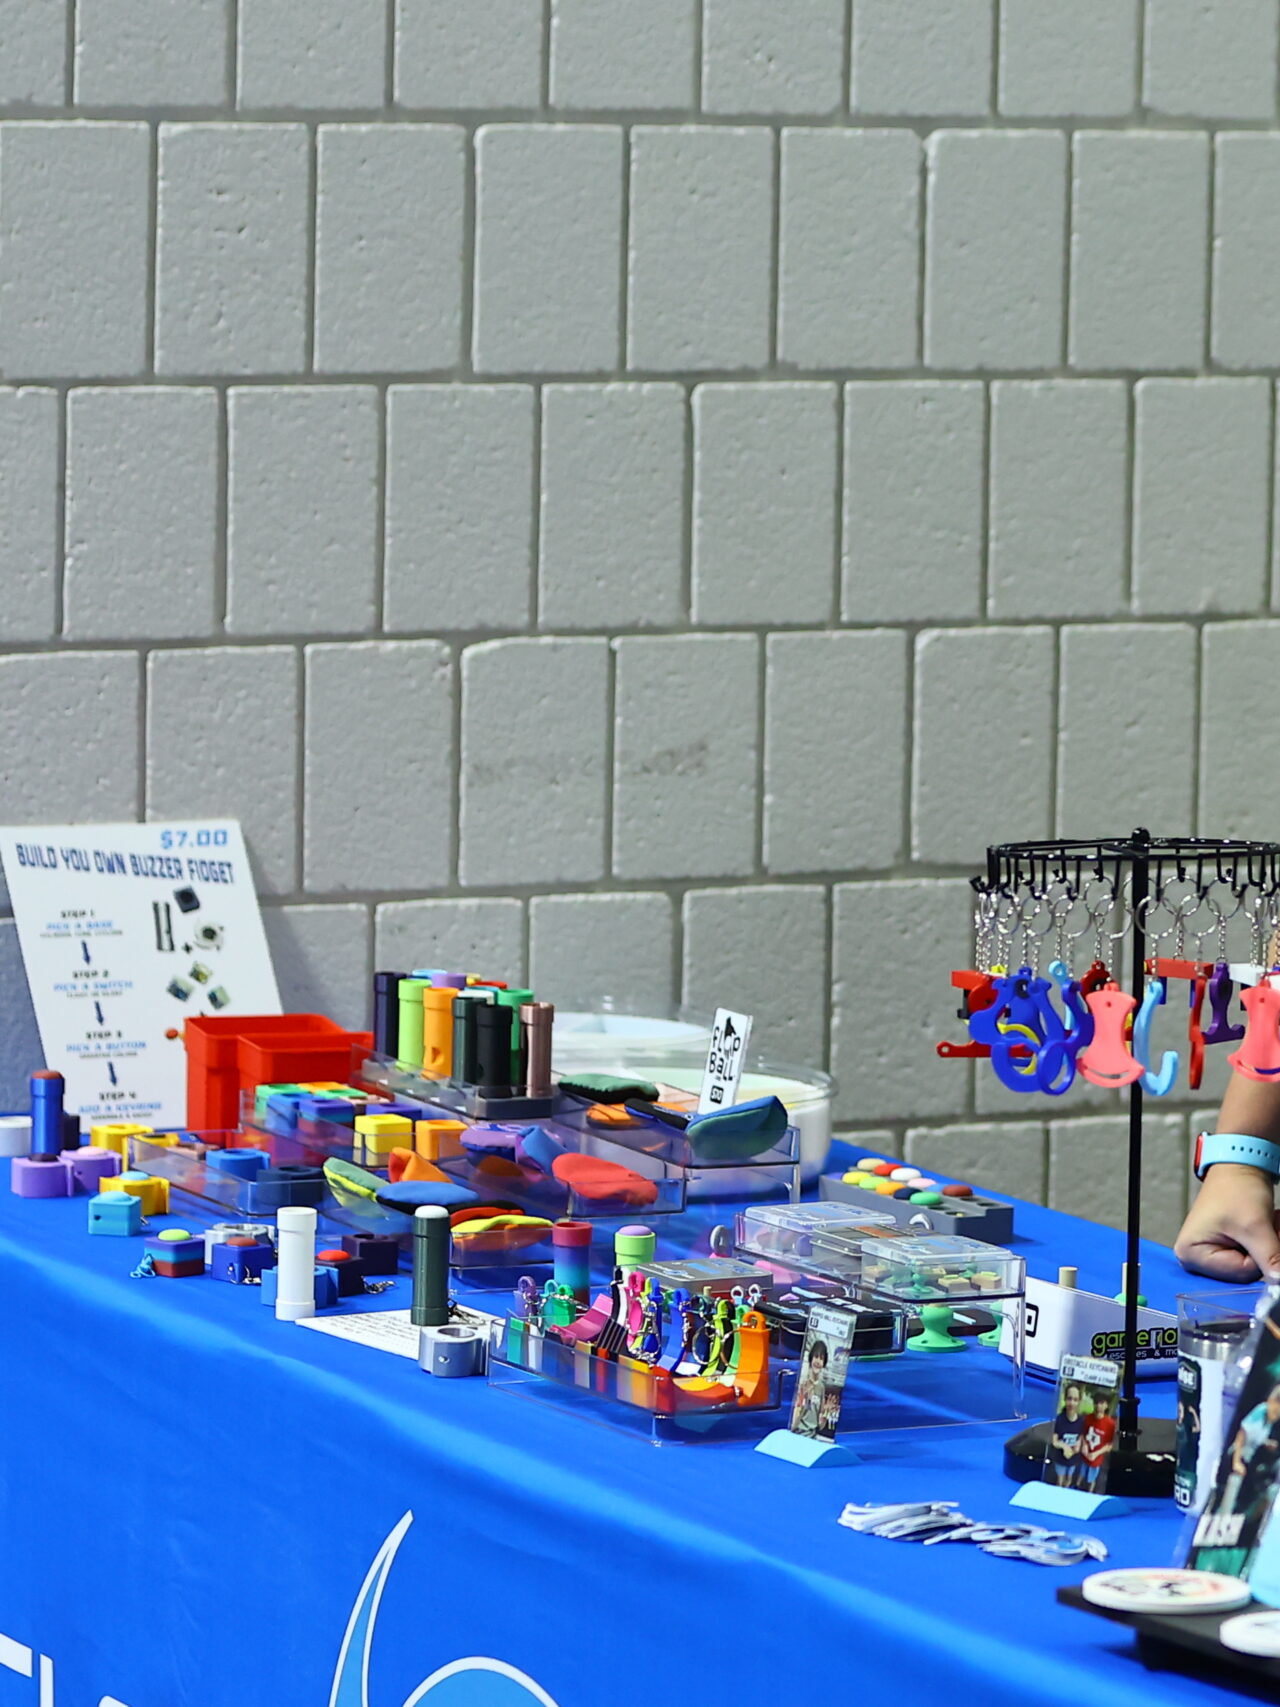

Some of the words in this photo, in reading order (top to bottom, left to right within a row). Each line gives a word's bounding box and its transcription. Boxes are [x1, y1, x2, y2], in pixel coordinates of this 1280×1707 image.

[160, 829, 228, 850] $7.00
[16, 842, 57, 870] BUILD
[60, 846, 91, 872] YOU
[94, 849, 128, 876] OWN
[129, 851, 184, 880] BUZZER
[187, 859, 236, 885] FIDGET
